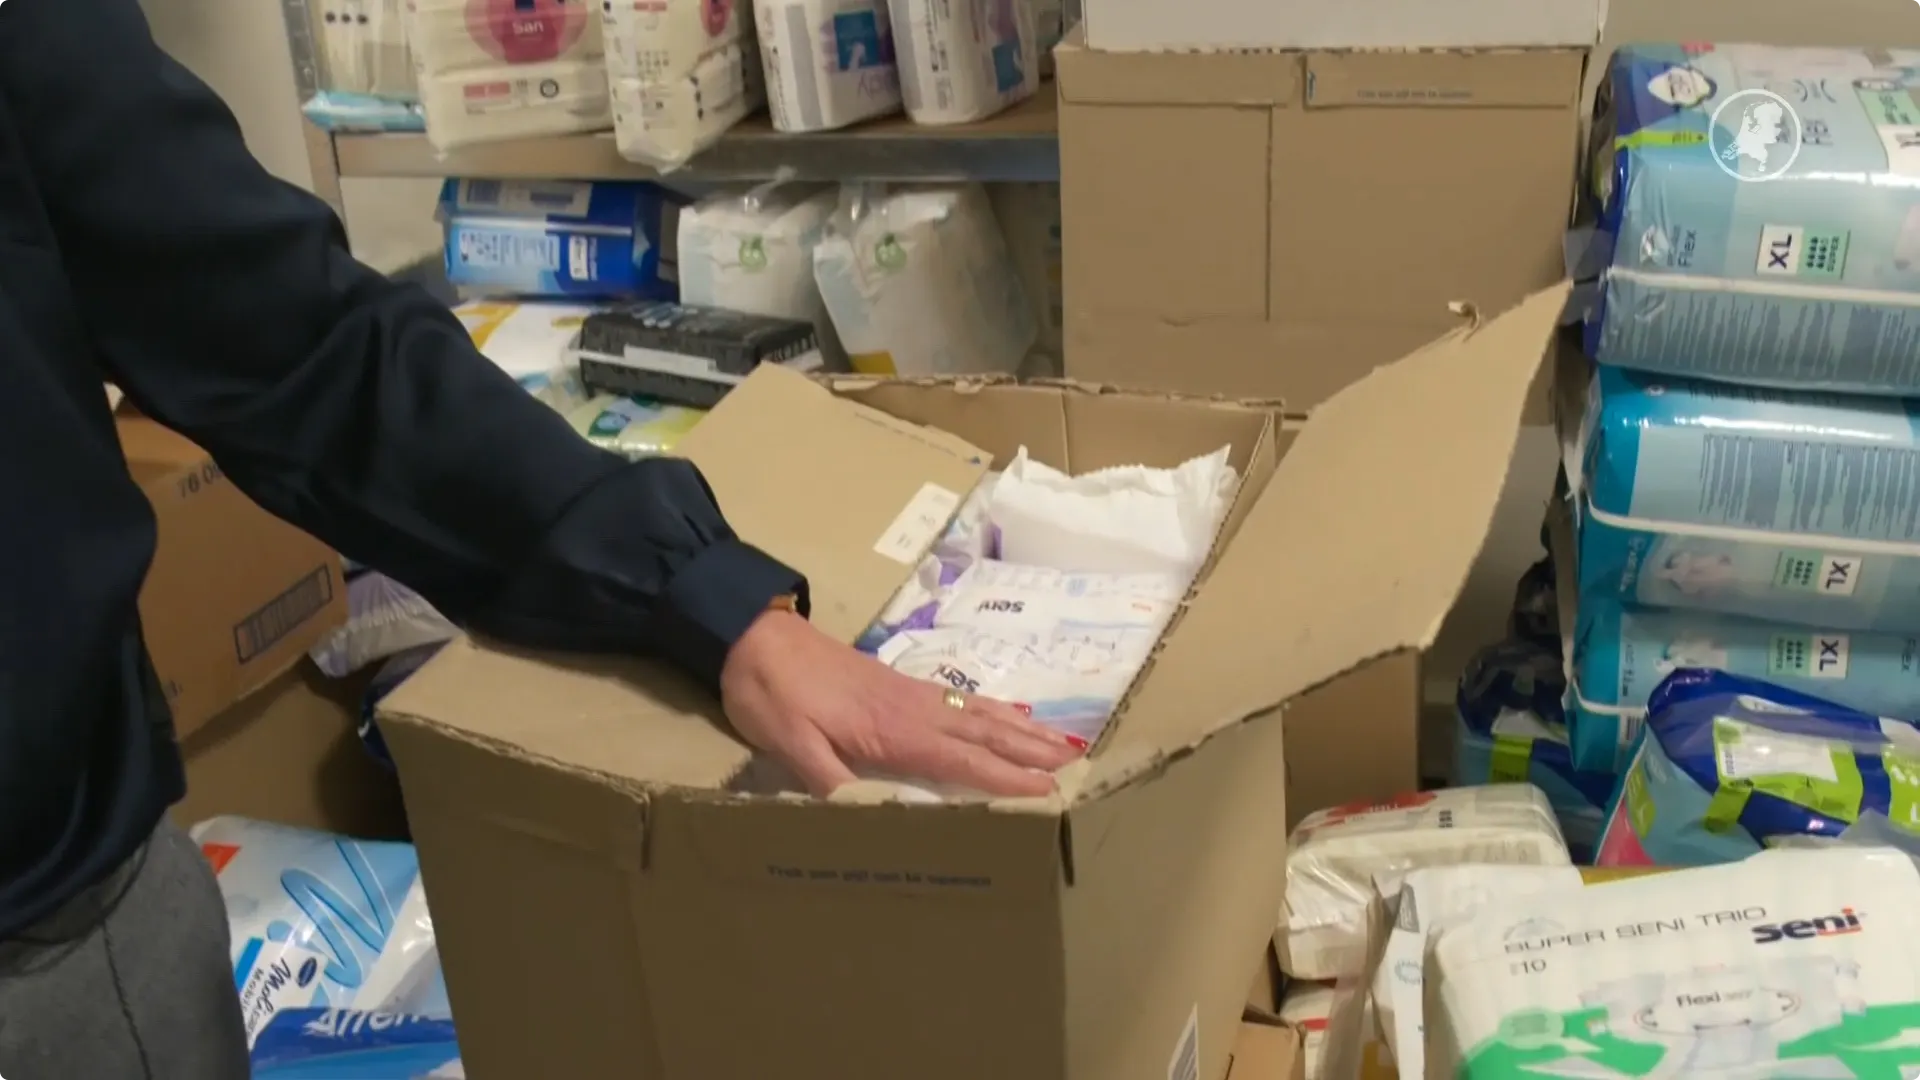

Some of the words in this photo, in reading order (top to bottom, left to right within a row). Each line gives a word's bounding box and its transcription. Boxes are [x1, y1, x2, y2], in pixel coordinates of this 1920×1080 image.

[1768, 233, 1793, 270] XL
[1825, 560, 1851, 590] XL
[974, 599, 1025, 614] seni
[1818, 638, 1840, 672] XL
[929, 662, 981, 695] seni
[1504, 930, 1606, 954] SUPER
[1616, 918, 1686, 939] SENI
[1697, 907, 1768, 927] TRIO
[1751, 907, 1862, 944] seni
[1518, 958, 1548, 974] 10
